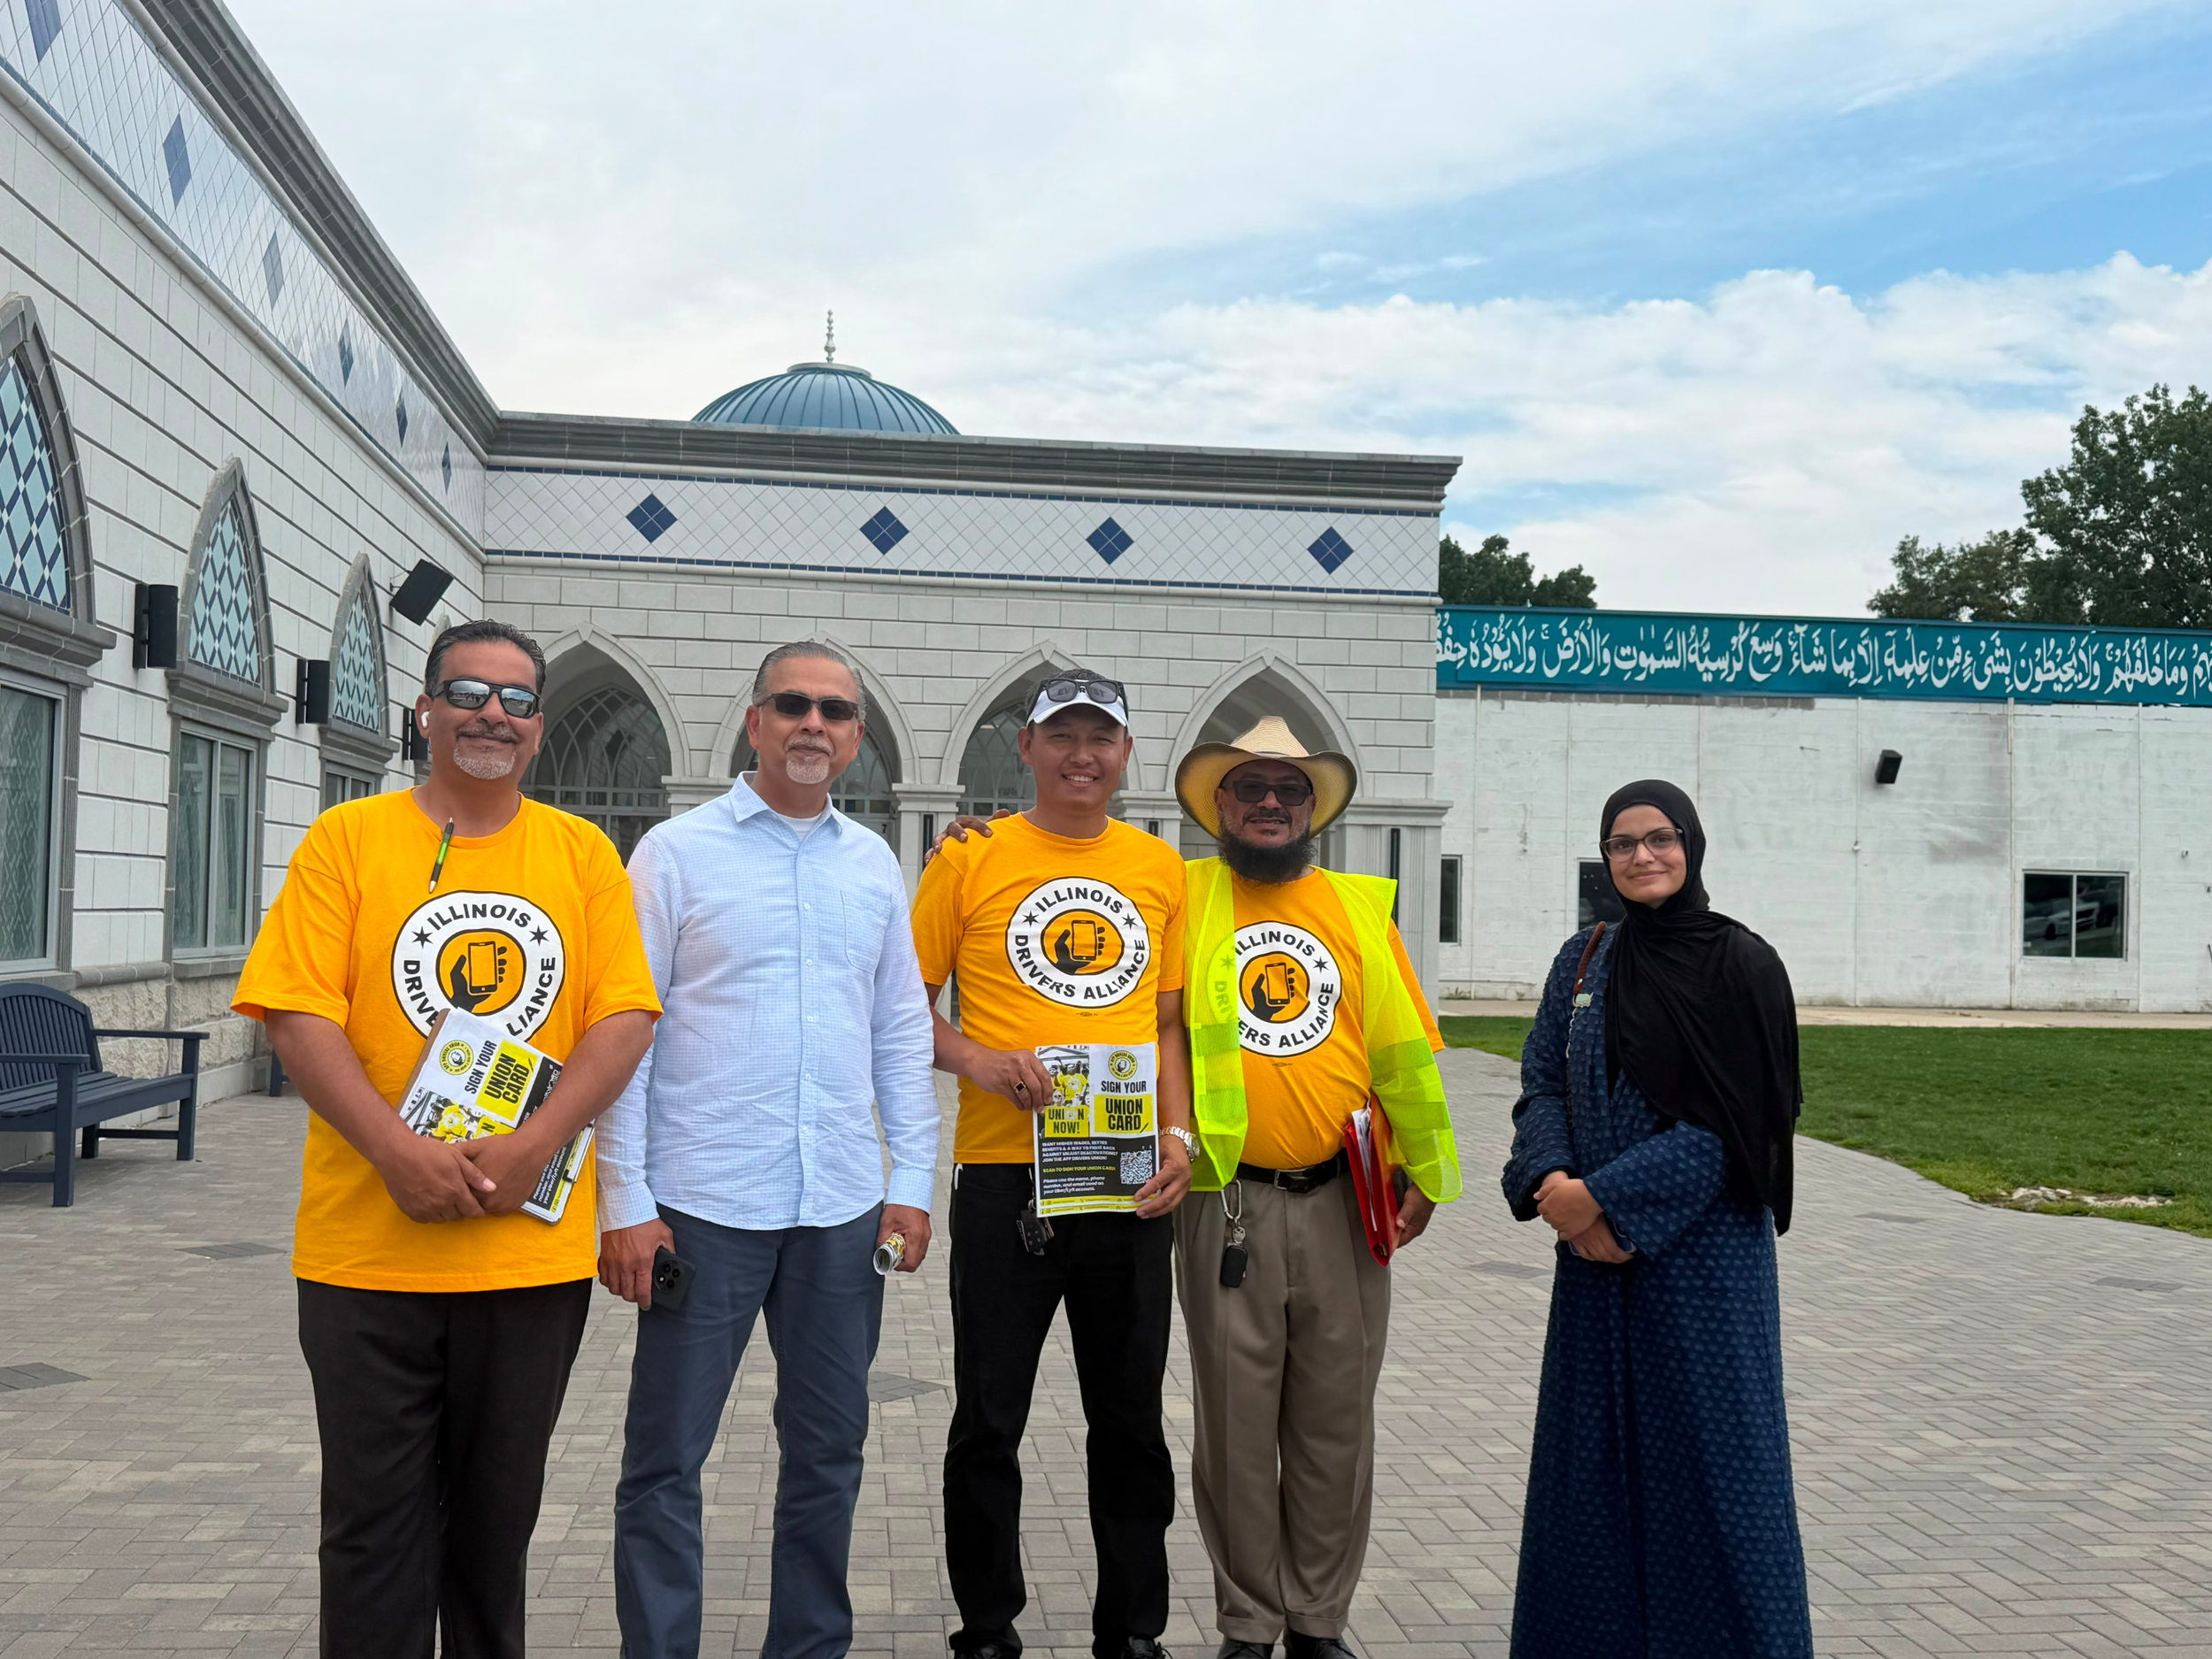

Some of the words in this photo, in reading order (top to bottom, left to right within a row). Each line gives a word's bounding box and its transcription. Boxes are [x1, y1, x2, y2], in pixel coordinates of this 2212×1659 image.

[881, 824, 887, 833] 7
[1035, 887, 1123, 914] ILLINOIS
[426, 903, 531, 930] ILLINOIS
[1232, 931, 1316, 956] ILLINOIS
[1015, 935, 1076, 997] DRIVERS
[1083, 940, 1145, 999] ALLIANCE
[506, 957, 556, 1036] LIANCE
[1279, 983, 1333, 1048] ALLIANCE
[465, 1069, 485, 1094] SIGN
[476, 1040, 497, 1068] YOUR
[484, 1053, 516, 1100] UNION
[503, 1063, 530, 1104] CARD
[1101, 1080, 1121, 1093] SIGN
[1124, 1080, 1147, 1093] YOUR
[1105, 1098, 1143, 1115] UNION
[1053, 1121, 1080, 1133] NOW!
[1108, 1115, 1141, 1131] CARD
